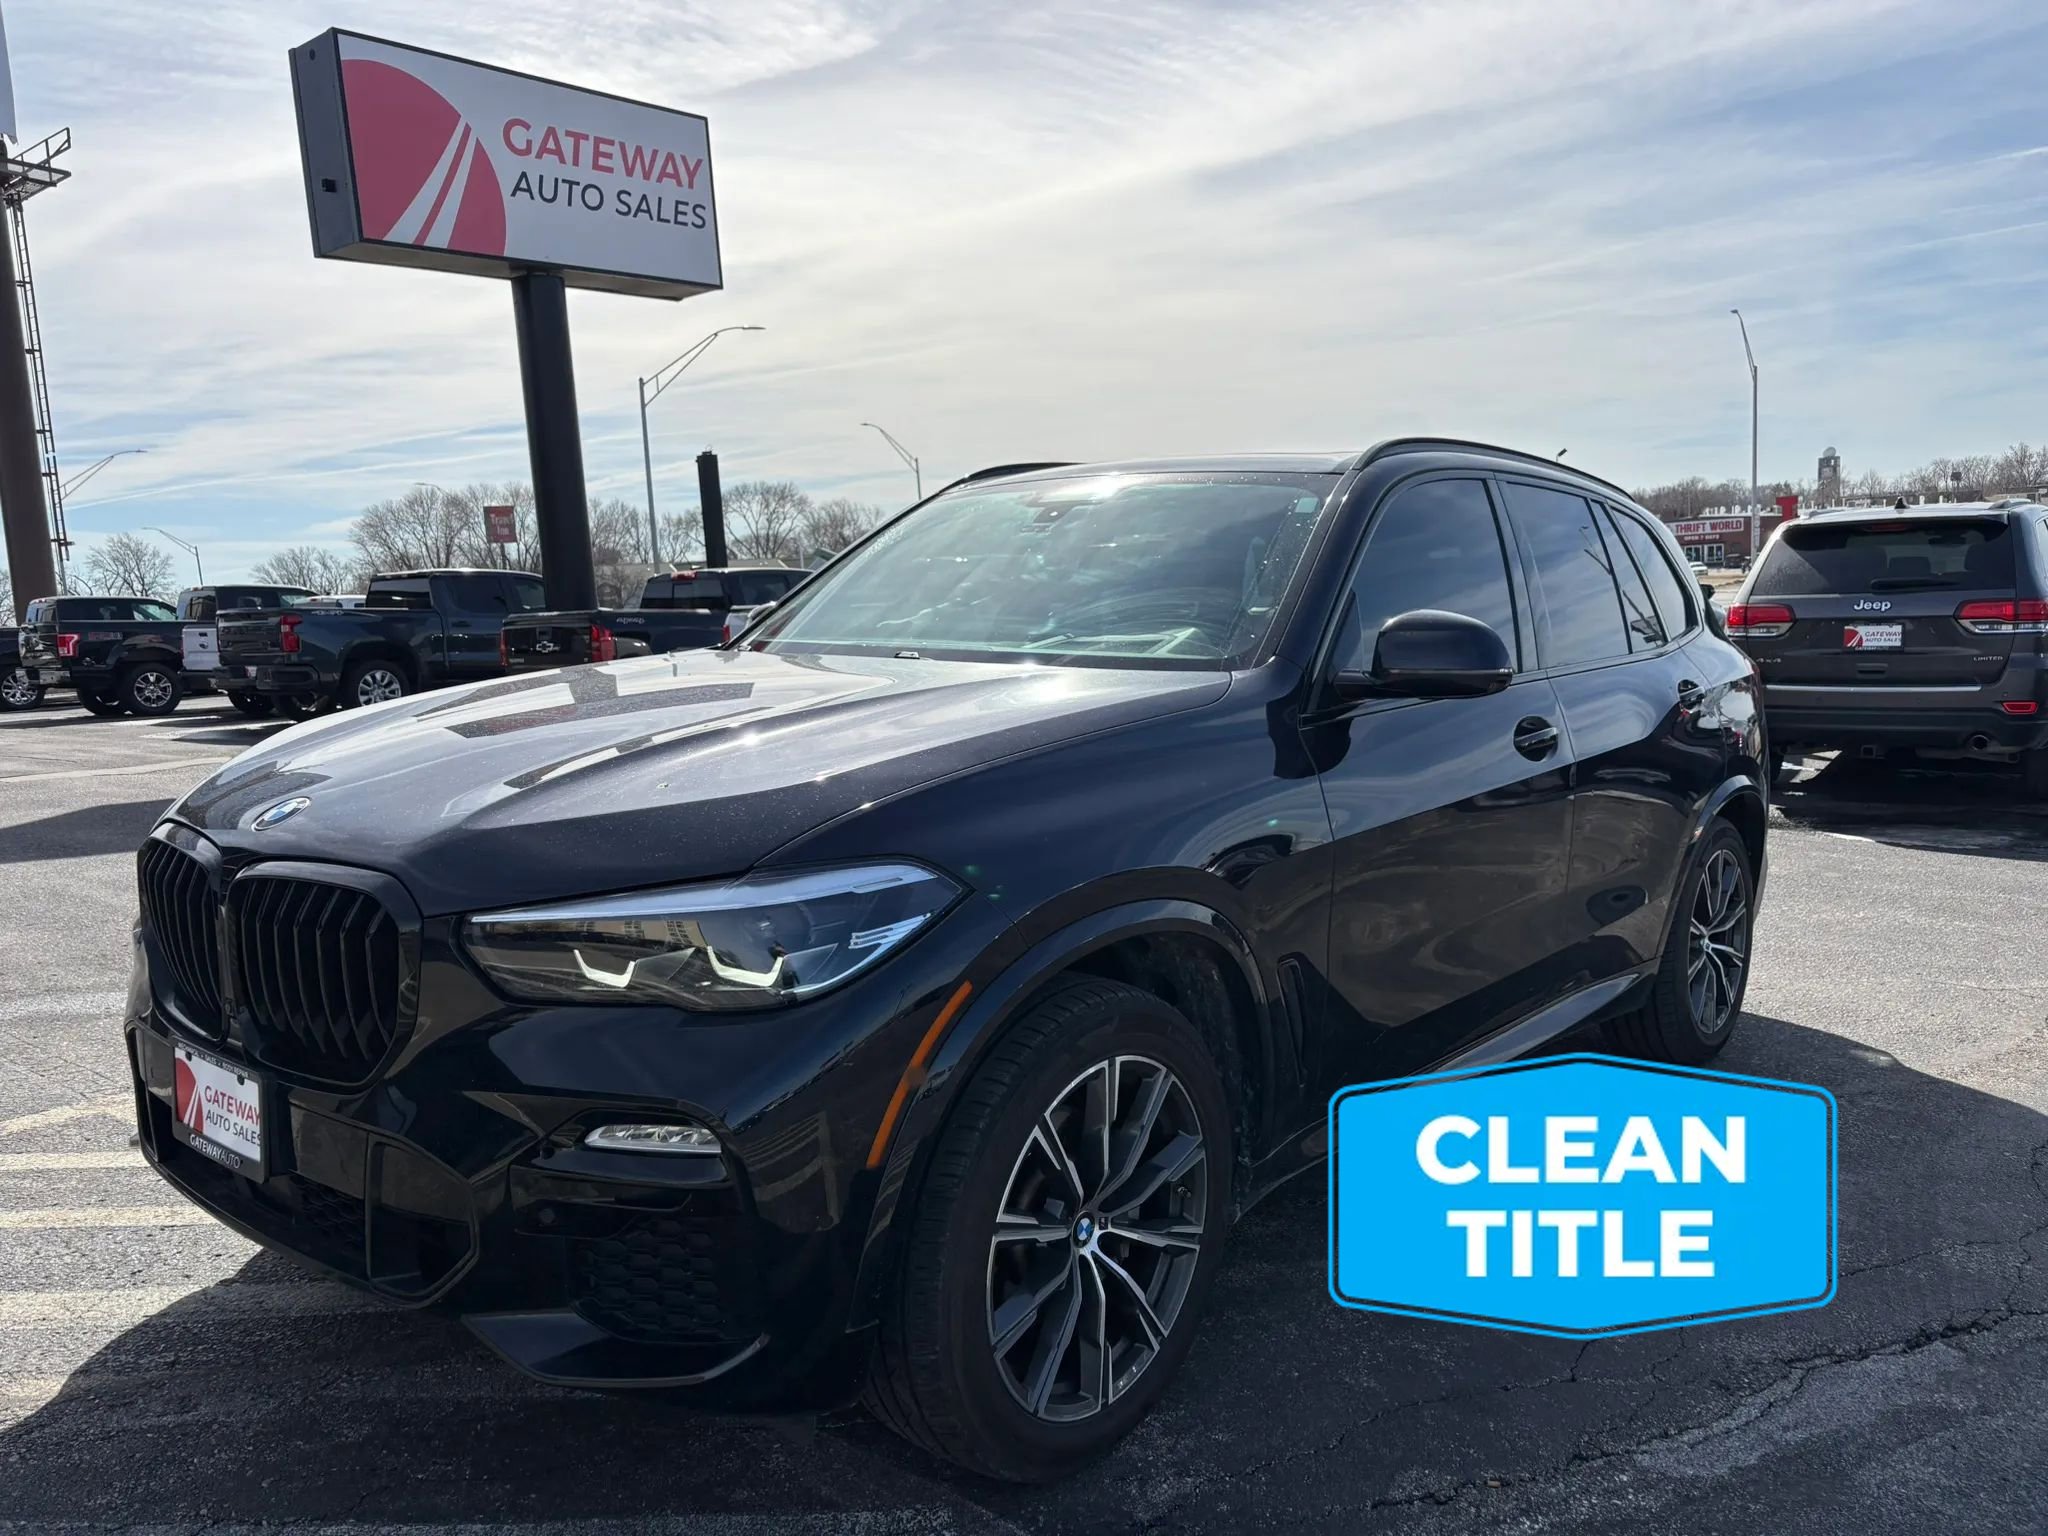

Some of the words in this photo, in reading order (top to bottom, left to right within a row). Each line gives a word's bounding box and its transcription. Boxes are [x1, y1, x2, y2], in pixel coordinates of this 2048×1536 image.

[503, 117, 704, 190] GATEWAY
[510, 171, 604, 212] AUTO
[615, 189, 707, 230] SALES
[1675, 522, 1707, 534] THRIFT
[1710, 520, 1742, 532] WORLD
[1853, 599, 1891, 612] Jeep
[204, 1085, 261, 1126] GATEWAY
[205, 1109, 231, 1132] AUTO
